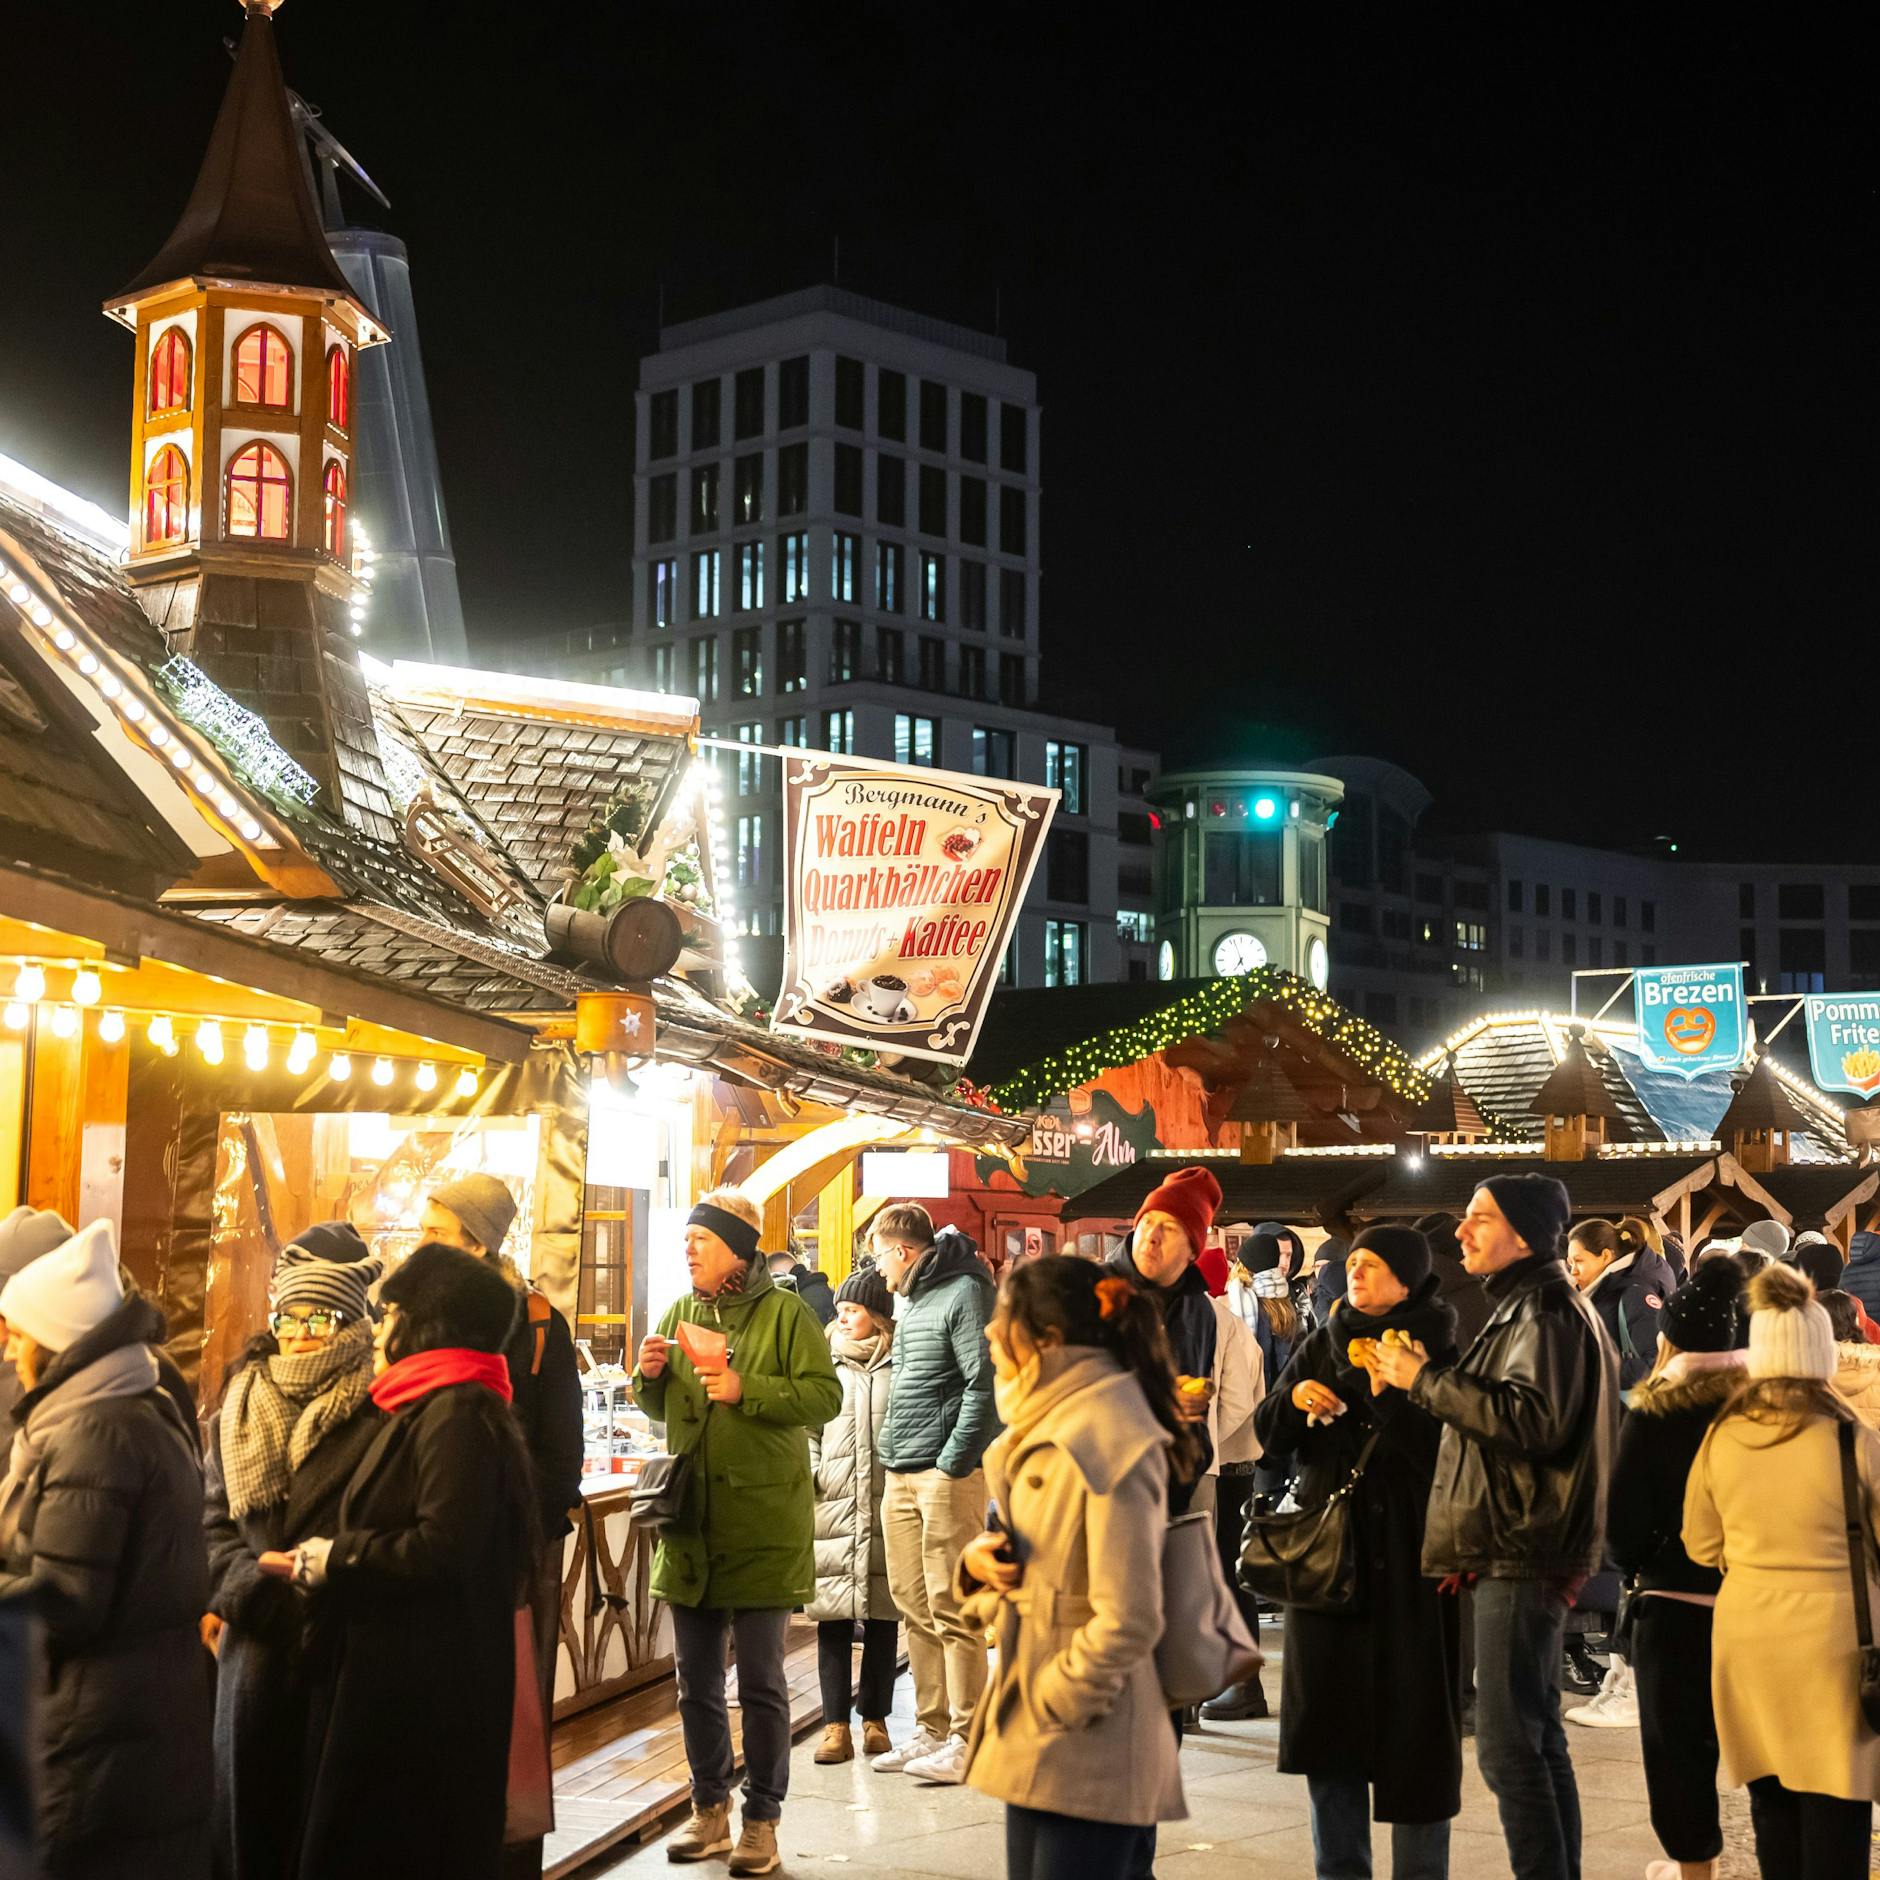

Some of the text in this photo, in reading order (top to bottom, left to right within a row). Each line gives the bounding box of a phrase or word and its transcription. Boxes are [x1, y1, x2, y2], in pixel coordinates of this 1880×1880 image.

[815, 813, 927, 858] Waffeln
[804, 864, 1002, 914] Quarkbällchen
[898, 914, 987, 958] Kaffee
[1644, 982, 1733, 1005] Brezen
[1660, 970, 1715, 985] ofenfrische
[1812, 1000, 1880, 1021] Pomm
[1033, 1129, 1076, 1157] sser
[1092, 1121, 1136, 1166] Alm
